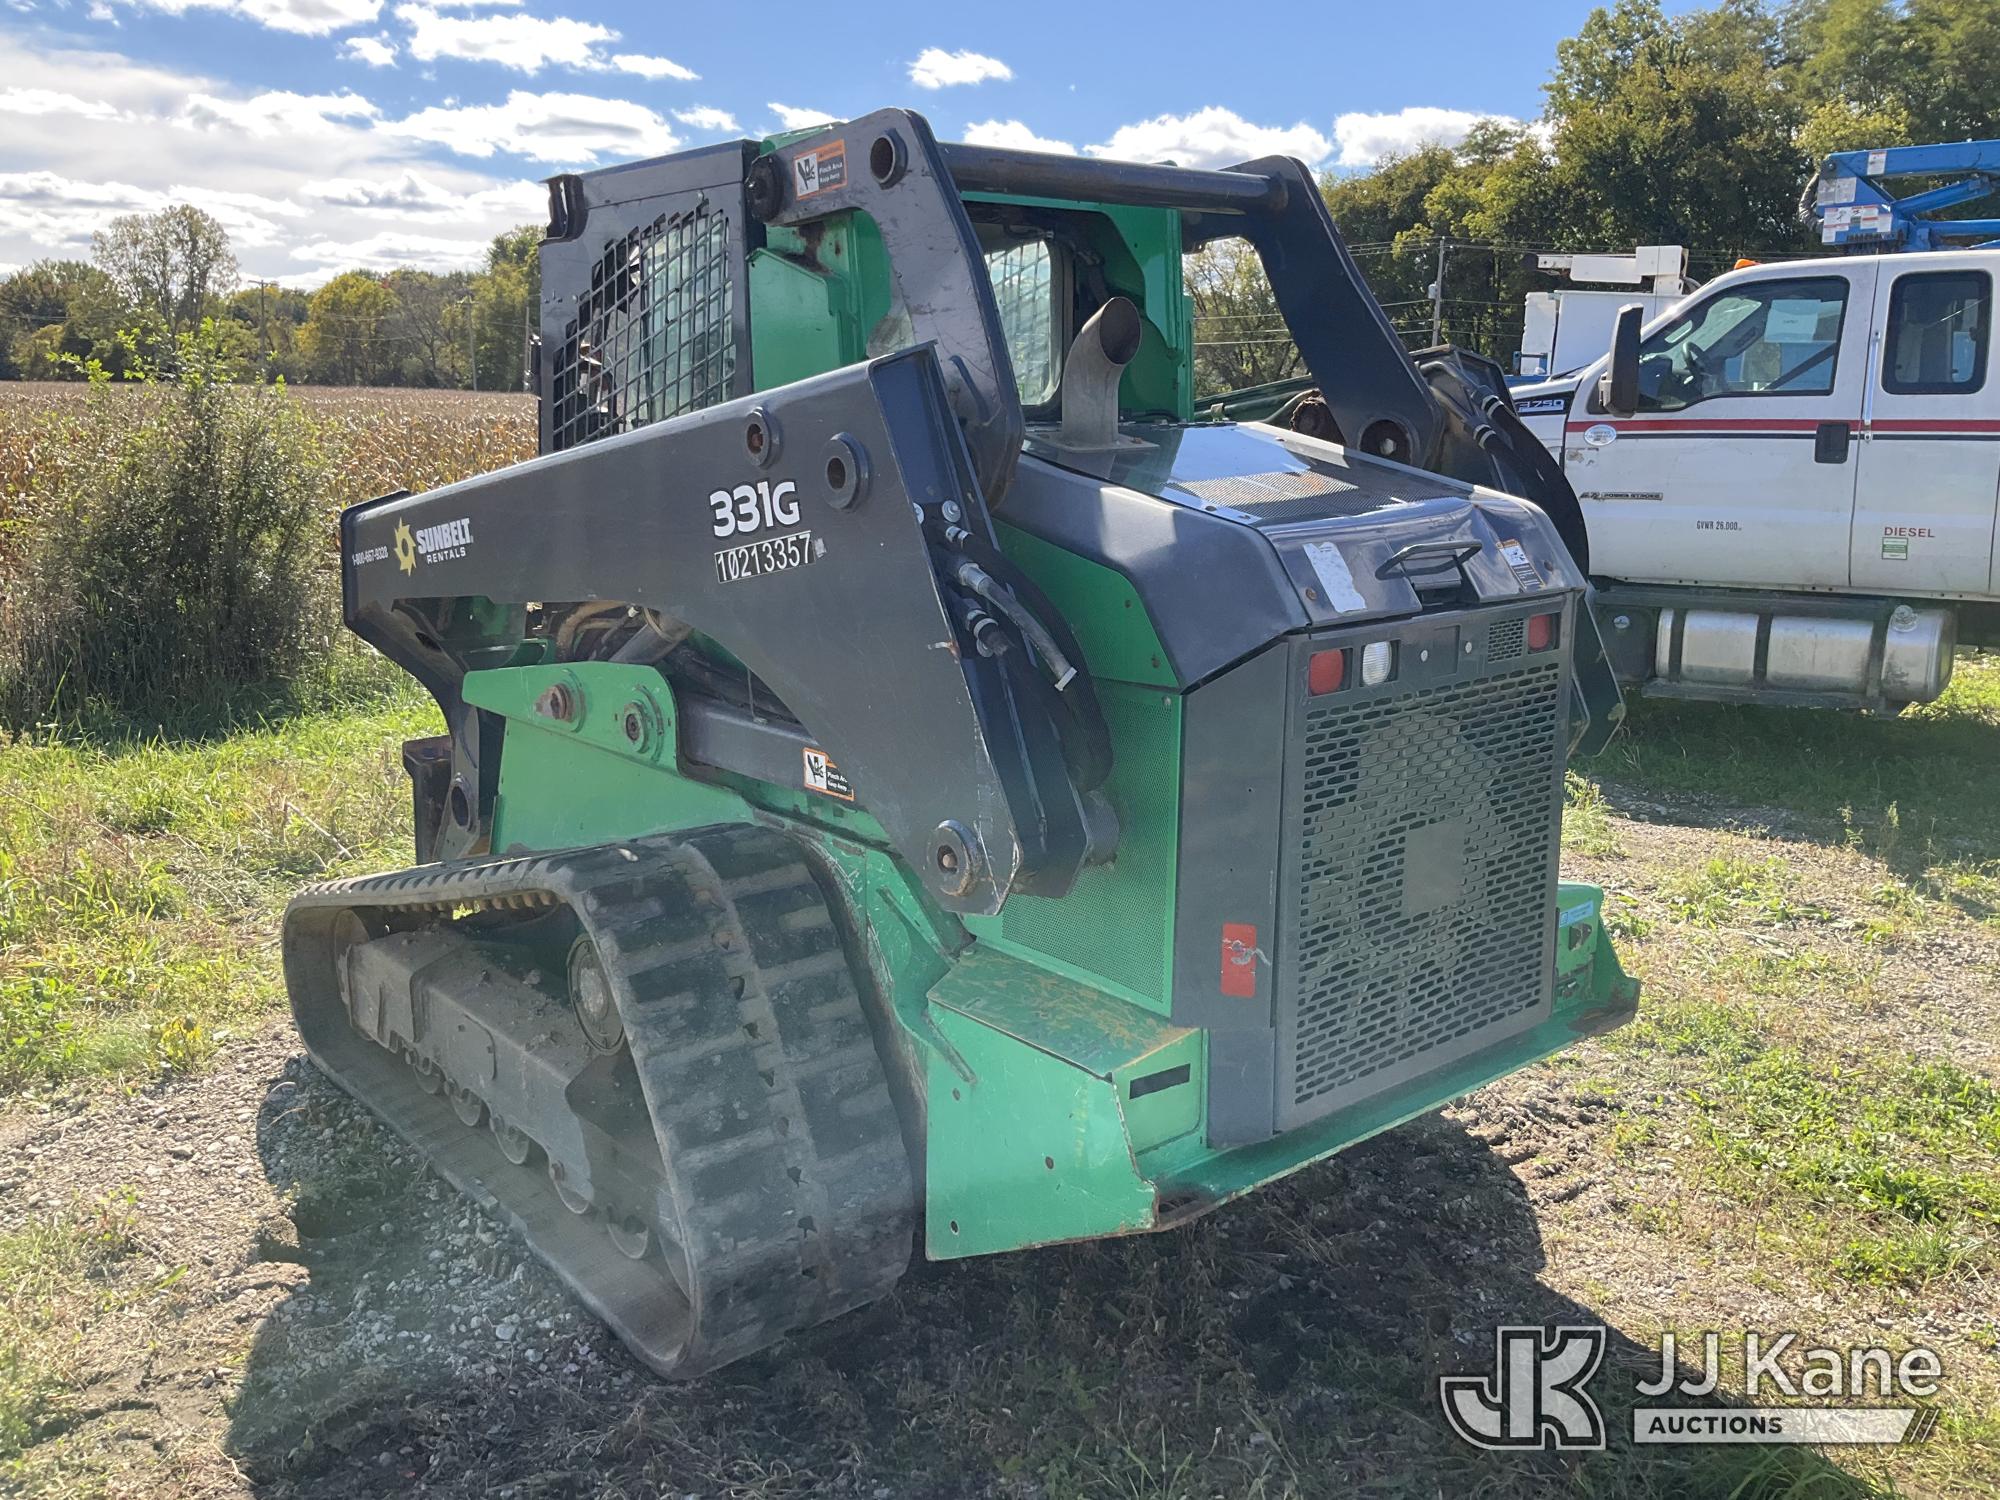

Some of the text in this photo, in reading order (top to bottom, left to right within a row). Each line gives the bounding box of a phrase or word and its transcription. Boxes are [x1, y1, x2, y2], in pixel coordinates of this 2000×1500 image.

[709, 480, 801, 537] 331G
[416, 518, 470, 554] SUNBELT
[1696, 520, 1714, 529] GVWR
[1884, 526, 1935, 538] DIESEL
[426, 546, 467, 565] RENTALS
[718, 533, 811, 581] 10213357
